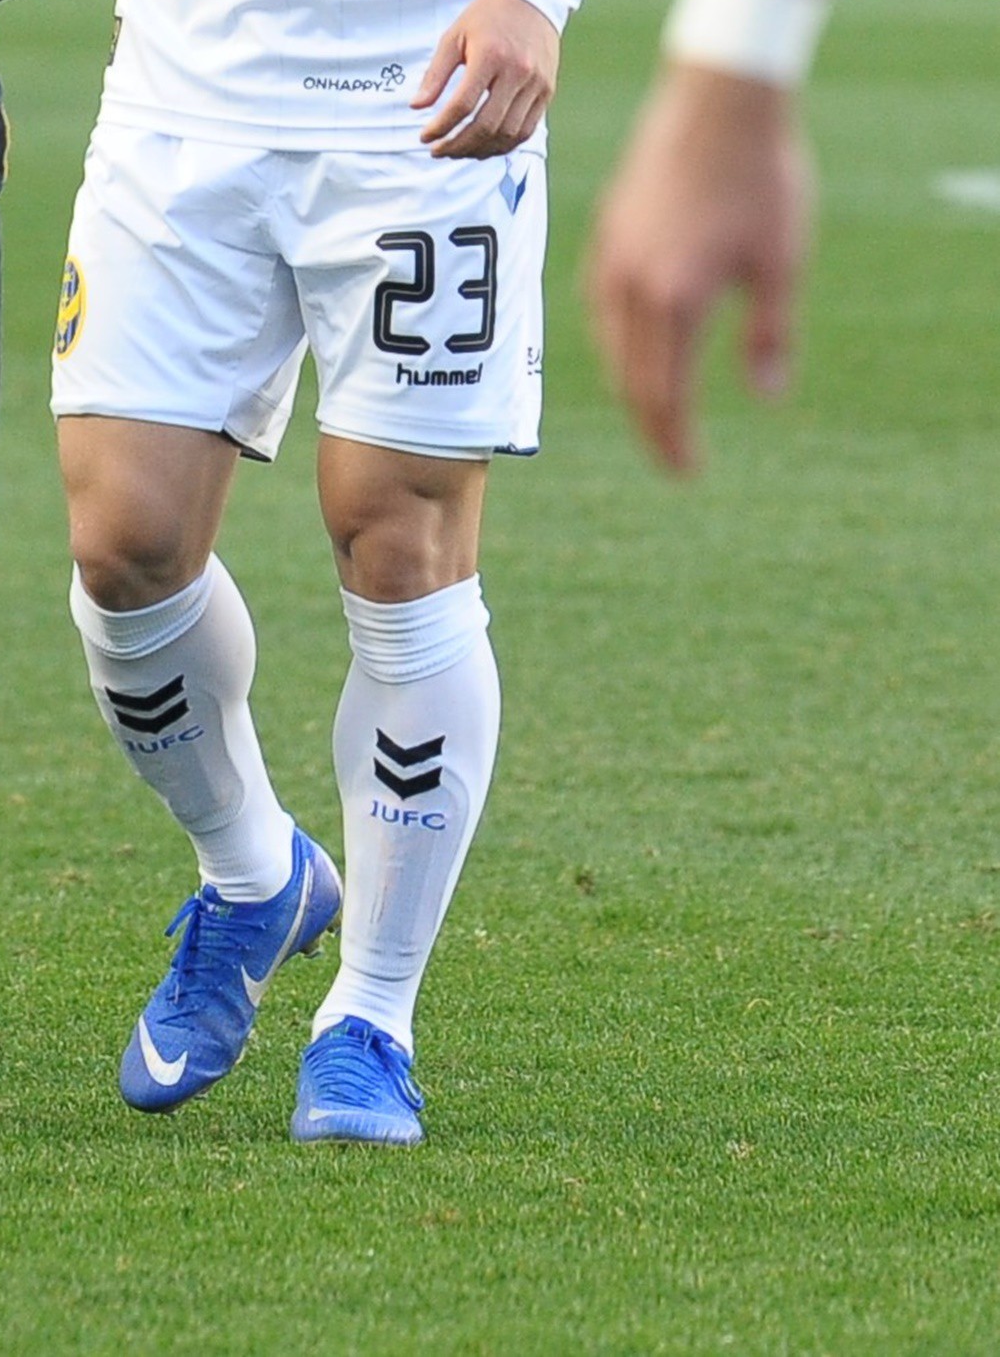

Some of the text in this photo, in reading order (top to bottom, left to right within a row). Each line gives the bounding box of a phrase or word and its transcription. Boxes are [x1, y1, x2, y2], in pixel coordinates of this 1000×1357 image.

[303, 76, 384, 92] ONHAPPY
[373, 225, 498, 356] 23
[396, 361, 484, 386] hummel
[369, 799, 447, 831] IUFC
